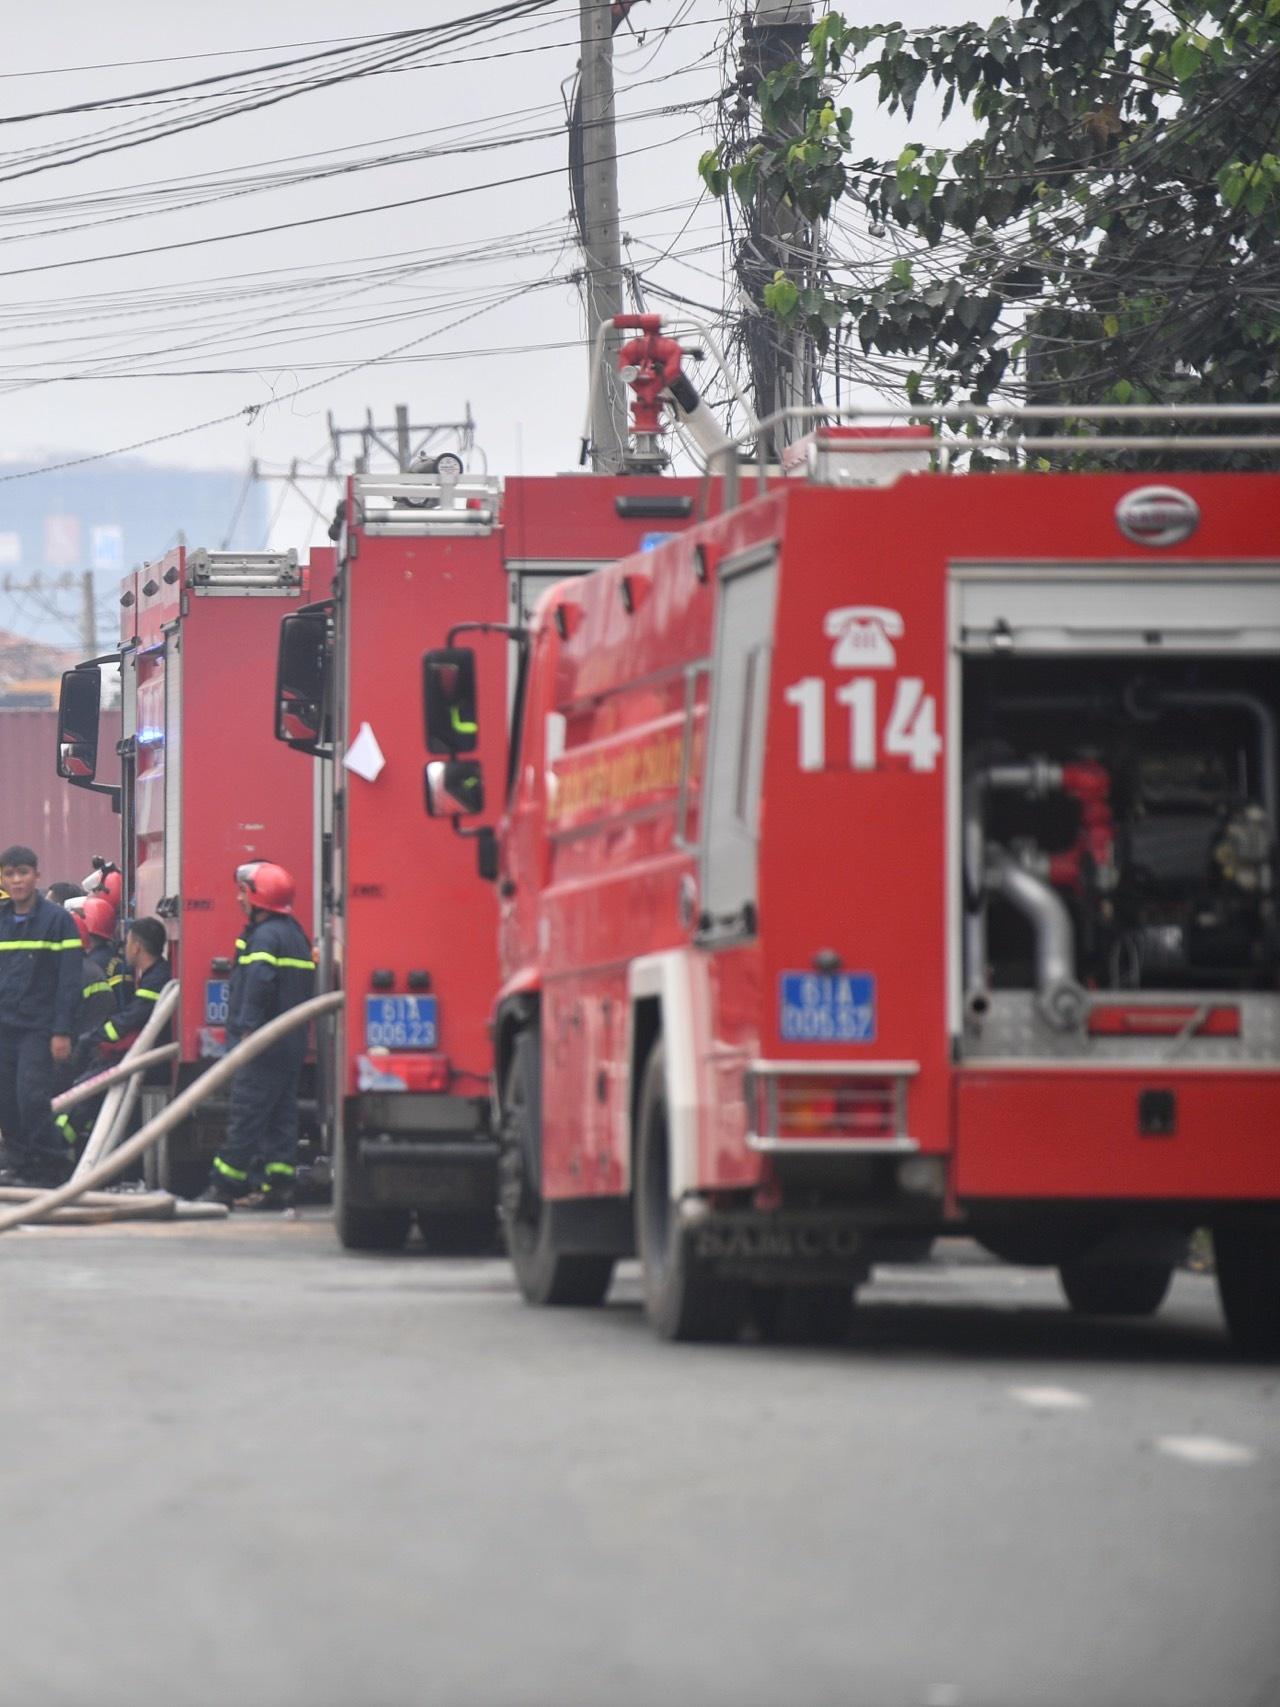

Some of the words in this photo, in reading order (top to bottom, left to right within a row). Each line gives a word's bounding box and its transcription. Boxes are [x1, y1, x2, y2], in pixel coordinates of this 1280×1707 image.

[785, 677, 943, 772] 114
[208, 1002, 229, 1021] 00
[382, 997, 420, 1021] 61A
